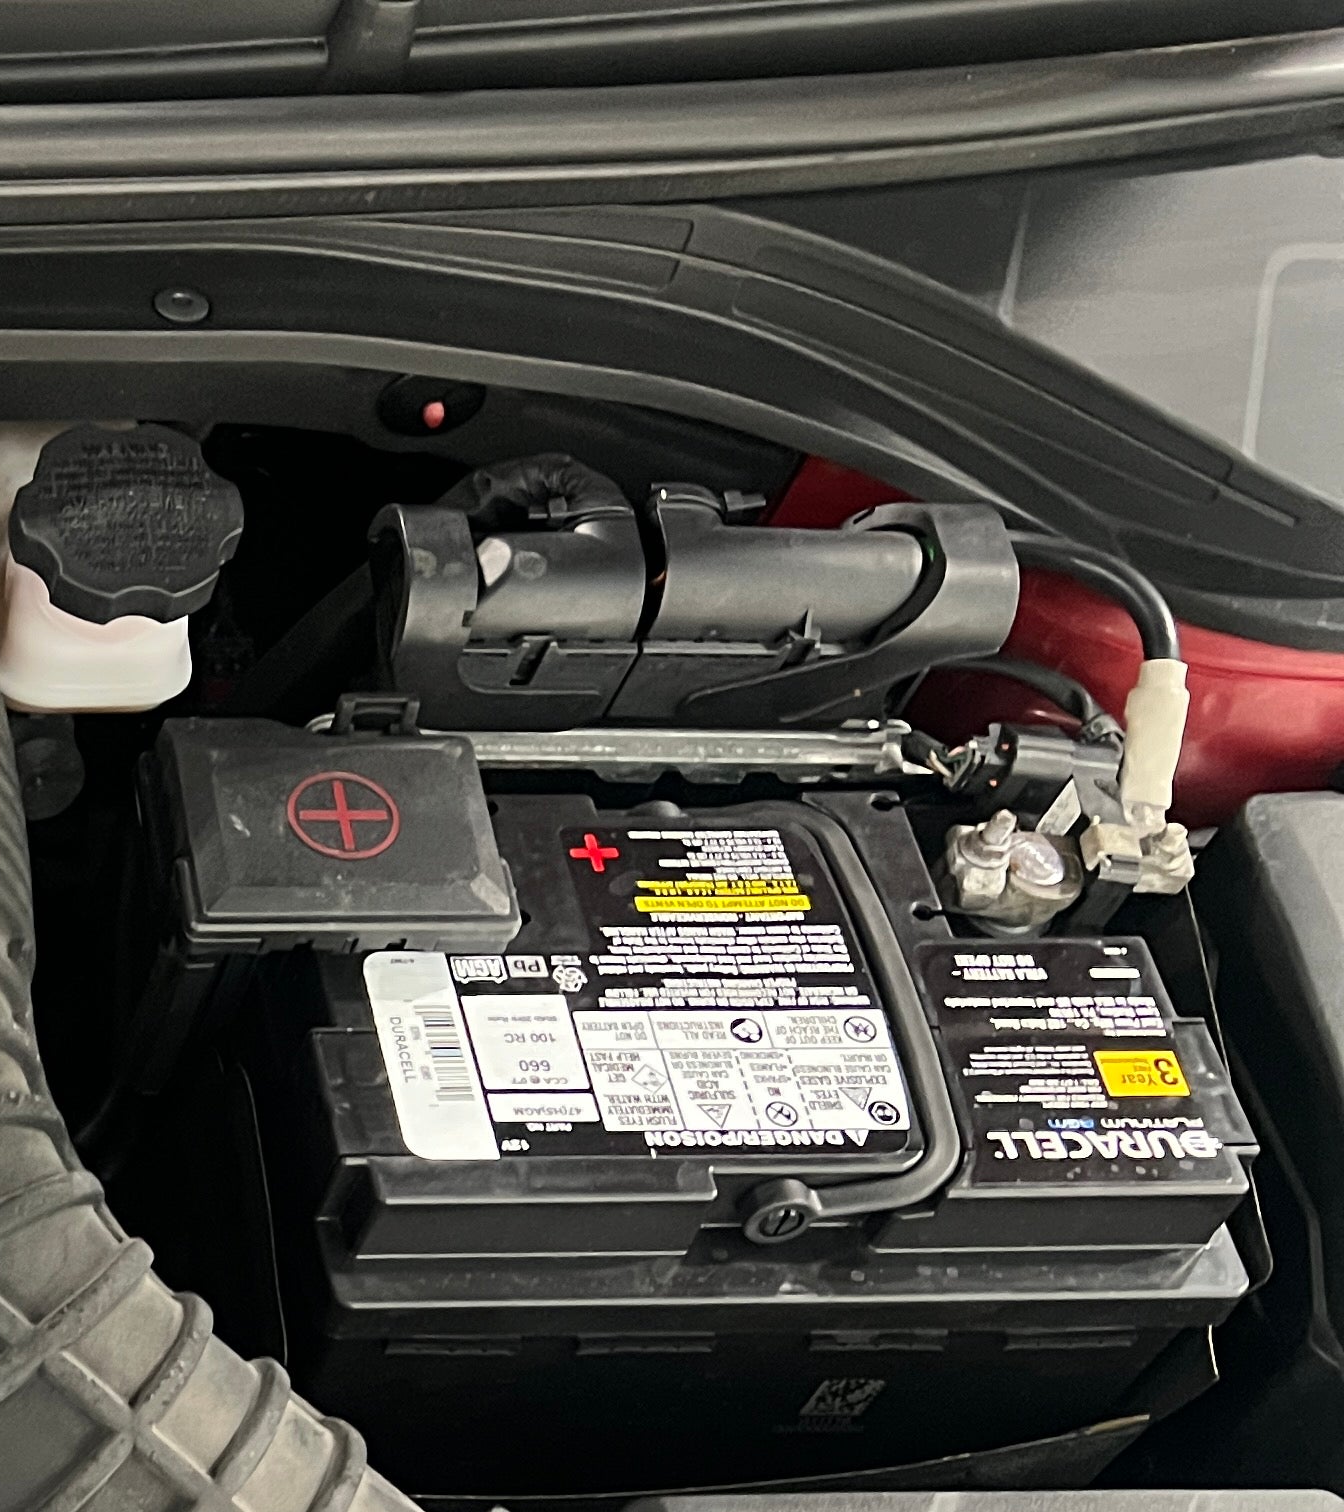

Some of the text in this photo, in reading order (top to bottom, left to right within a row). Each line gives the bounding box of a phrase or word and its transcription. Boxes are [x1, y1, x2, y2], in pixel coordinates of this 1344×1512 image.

[453, 958, 502, 976] AGM
[513, 959, 540, 973] Pb
[821, 1025, 839, 1034] THE
[503, 1032, 556, 1043] 100 RC
[682, 1031, 727, 1040] READ ALL
[389, 1016, 417, 1084] DURACELL
[615, 1051, 640, 1061] HELP
[519, 1059, 551, 1072] 660
[591, 1062, 634, 1072] MEDICAL
[1153, 1057, 1179, 1086] 3
[543, 1076, 568, 1085] CCA
[607, 1073, 626, 1083] GET
[798, 1075, 887, 1085] EXPLOSIVE GASES
[1120, 1073, 1157, 1087] Year
[696, 1079, 719, 1089] ACID
[643, 1094, 671, 1103] WITH
[687, 1090, 736, 1100] SULFURIC
[607, 1105, 674, 1115] IMMEDIATELY
[808, 1100, 843, 1111] SHIELD
[617, 1115, 678, 1126] FLUSH EYES
[1100, 1117, 1204, 1129] PLATINUM
[500, 1138, 530, 1151] 12V
[986, 1130, 1222, 1159] DURACELL
